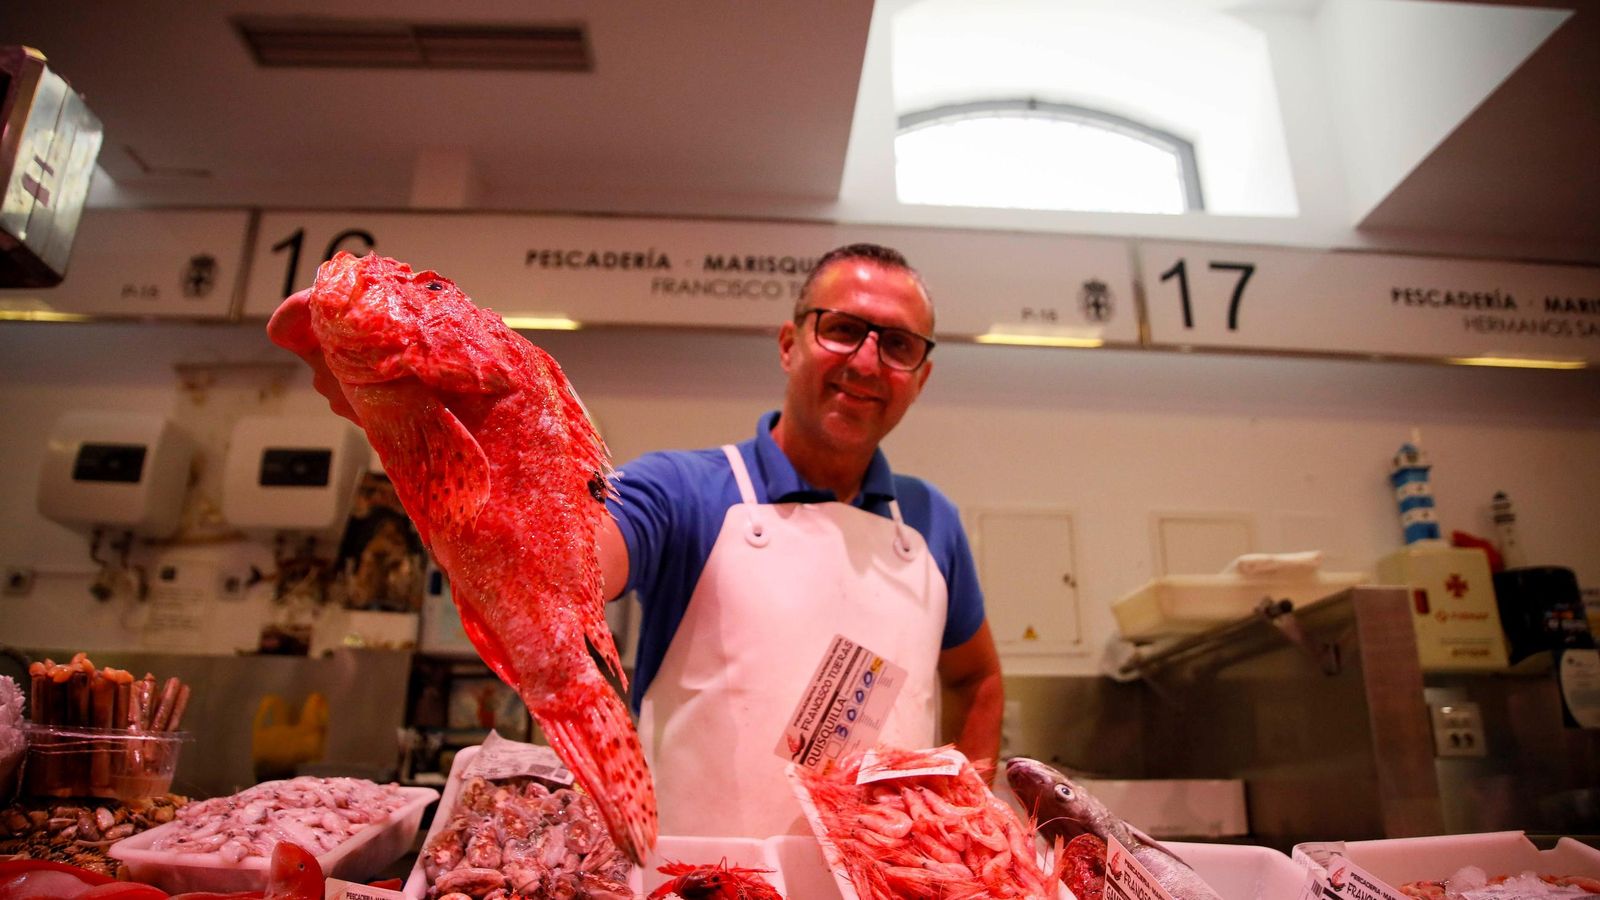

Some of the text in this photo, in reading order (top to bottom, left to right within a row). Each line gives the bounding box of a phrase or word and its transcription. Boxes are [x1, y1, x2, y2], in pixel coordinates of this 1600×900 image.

[525, 248, 820, 274] PESCADERÍA MARISQU
[651, 278, 784, 300] FRANCISCO
[1160, 257, 1256, 331] 17
[1391, 287, 1518, 310] PESCADERÍA
[800, 641, 854, 731] FRANCISCO TIJERAS
[807, 697, 848, 767] QUISQUILLA
